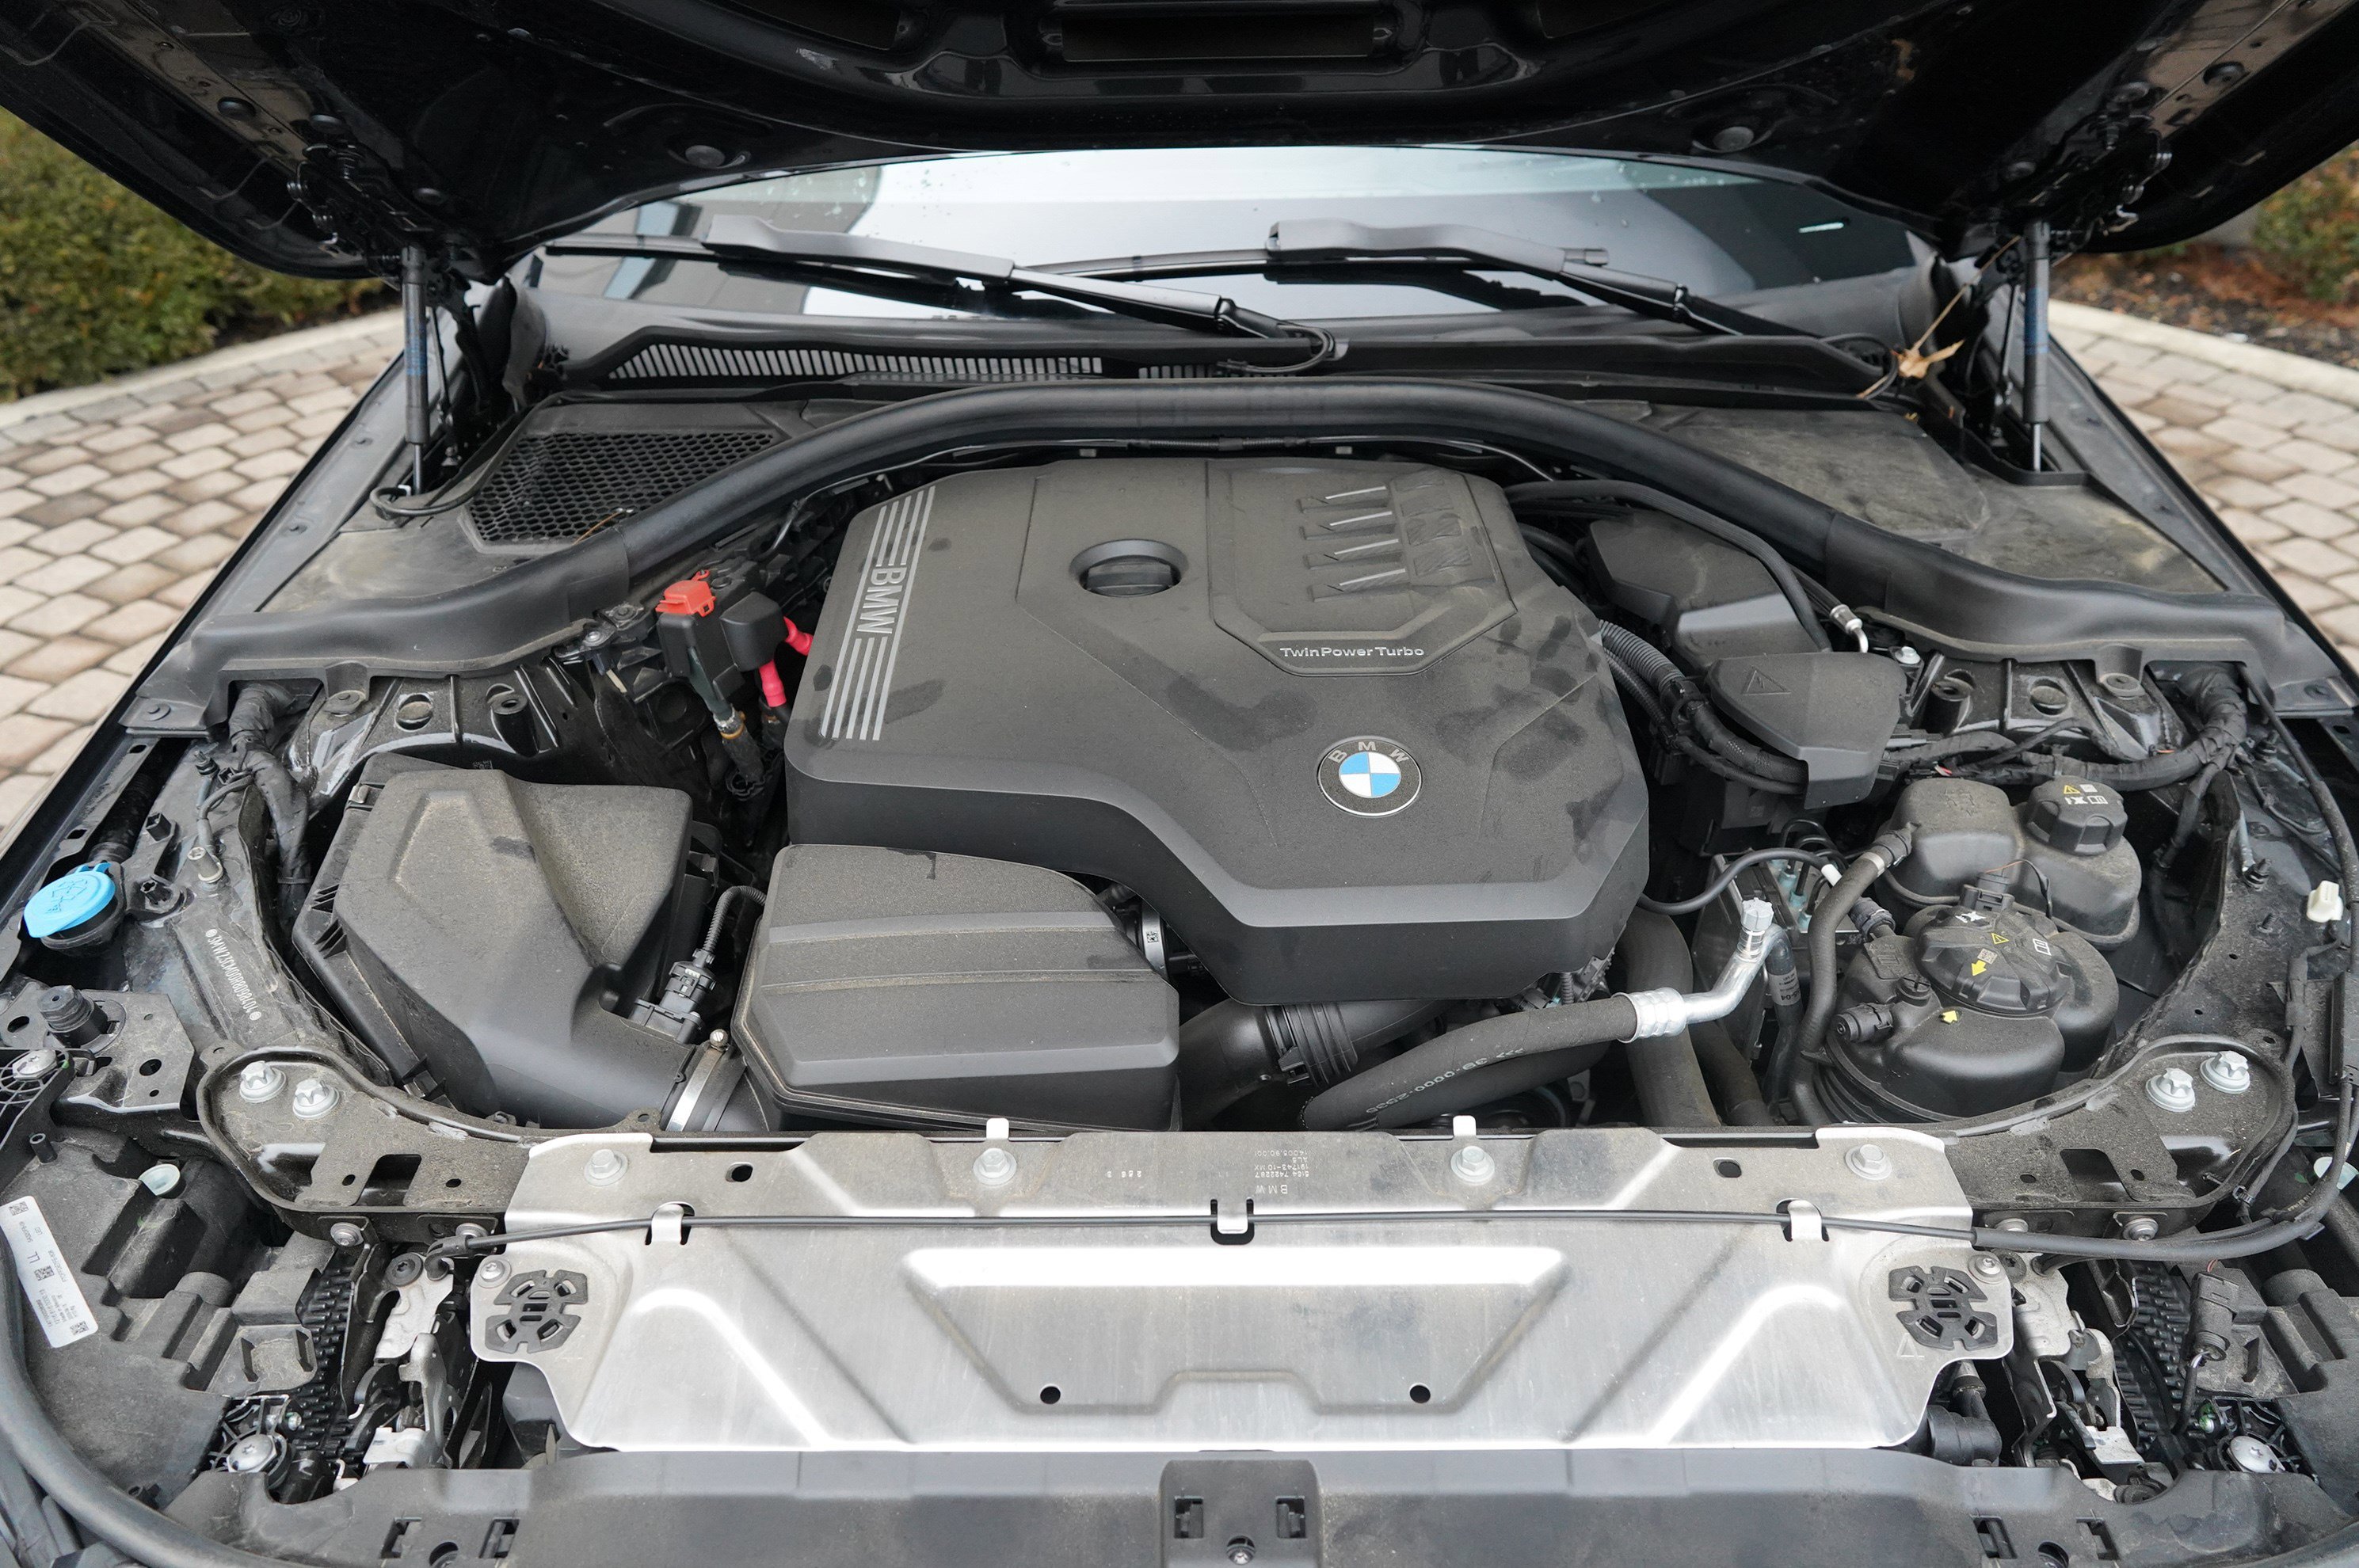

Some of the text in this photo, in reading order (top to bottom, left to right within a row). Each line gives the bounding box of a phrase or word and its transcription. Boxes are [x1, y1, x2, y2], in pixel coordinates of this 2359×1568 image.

[857, 567, 907, 634] BMW
[1374, 646, 1425, 657] Turbo
[1328, 741, 1410, 763] BMW
